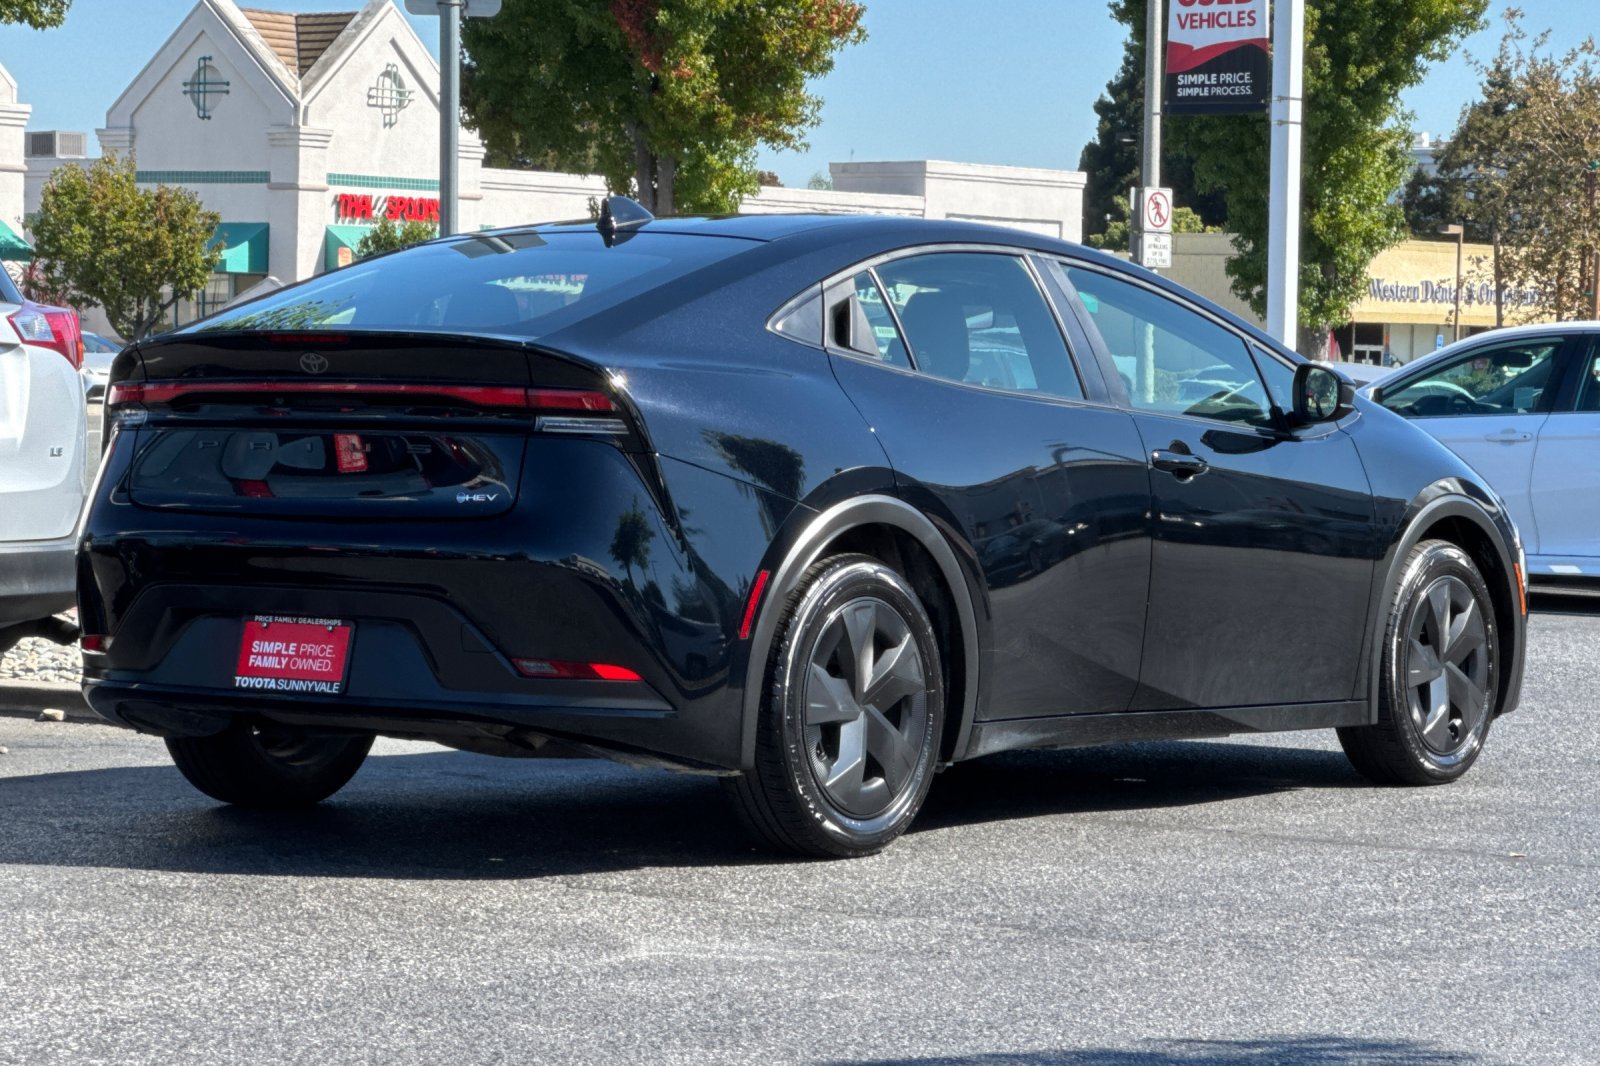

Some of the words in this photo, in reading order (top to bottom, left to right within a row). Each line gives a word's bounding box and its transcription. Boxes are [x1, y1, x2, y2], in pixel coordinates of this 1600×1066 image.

[1177, 10, 1256, 30] VEHICLES
[1177, 74, 1217, 85] SIMPLE
[1220, 72, 1253, 84] PRICE.
[1177, 87, 1209, 97] SIMPLE
[338, 193, 373, 219] THAI
[1369, 278, 1420, 302] Western
[49, 447, 63, 457] LE
[465, 493, 499, 502] HEV
[298, 617, 342, 626] DEALERSHIPS
[251, 640, 297, 655] SIMPLE
[300, 644, 335, 658] PRICE.
[248, 655, 288, 669] FAMILY
[290, 658, 333, 672] OWNED.
